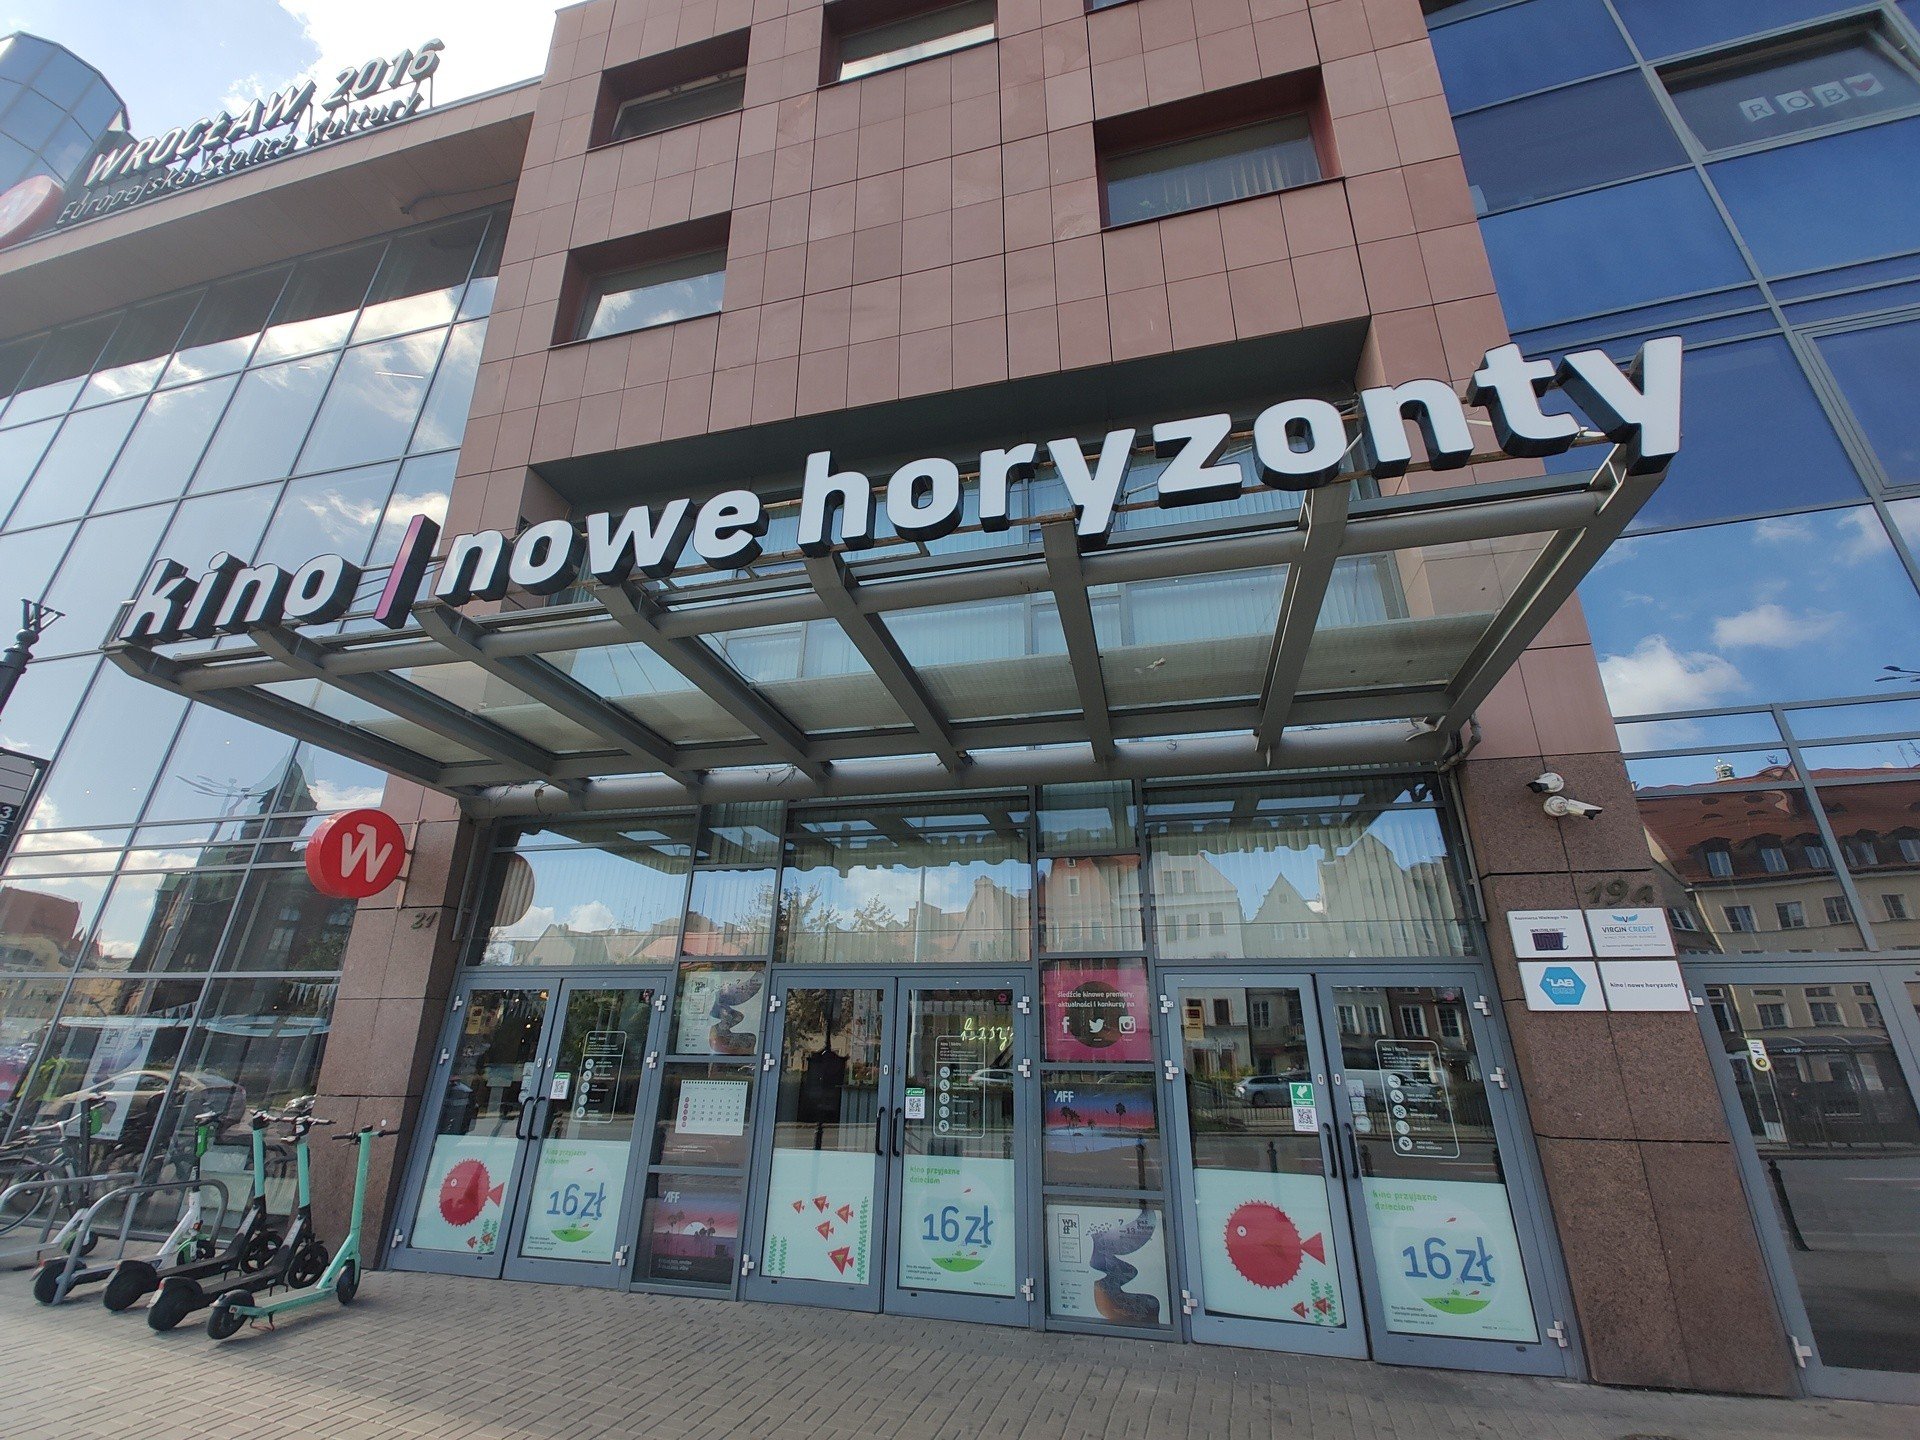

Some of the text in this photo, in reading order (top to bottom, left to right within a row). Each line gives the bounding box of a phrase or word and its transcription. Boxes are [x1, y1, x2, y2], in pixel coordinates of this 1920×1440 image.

[84, 38, 445, 188] WROCŁAW 2016
[202, 134, 298, 182] Stolica
[305, 93, 424, 147] Kultury
[119, 336, 1683, 643] kino nowe horyzonty
[411, 912, 437, 930] 21
[1097, 1001, 1126, 1009] konkursy
[1373, 1189, 1438, 1203] kino przyjazne
[1375, 1203, 1415, 1211] dzieciom
[922, 1205, 994, 1245] 16 zł
[1402, 1236, 1495, 1284] 16 zł
